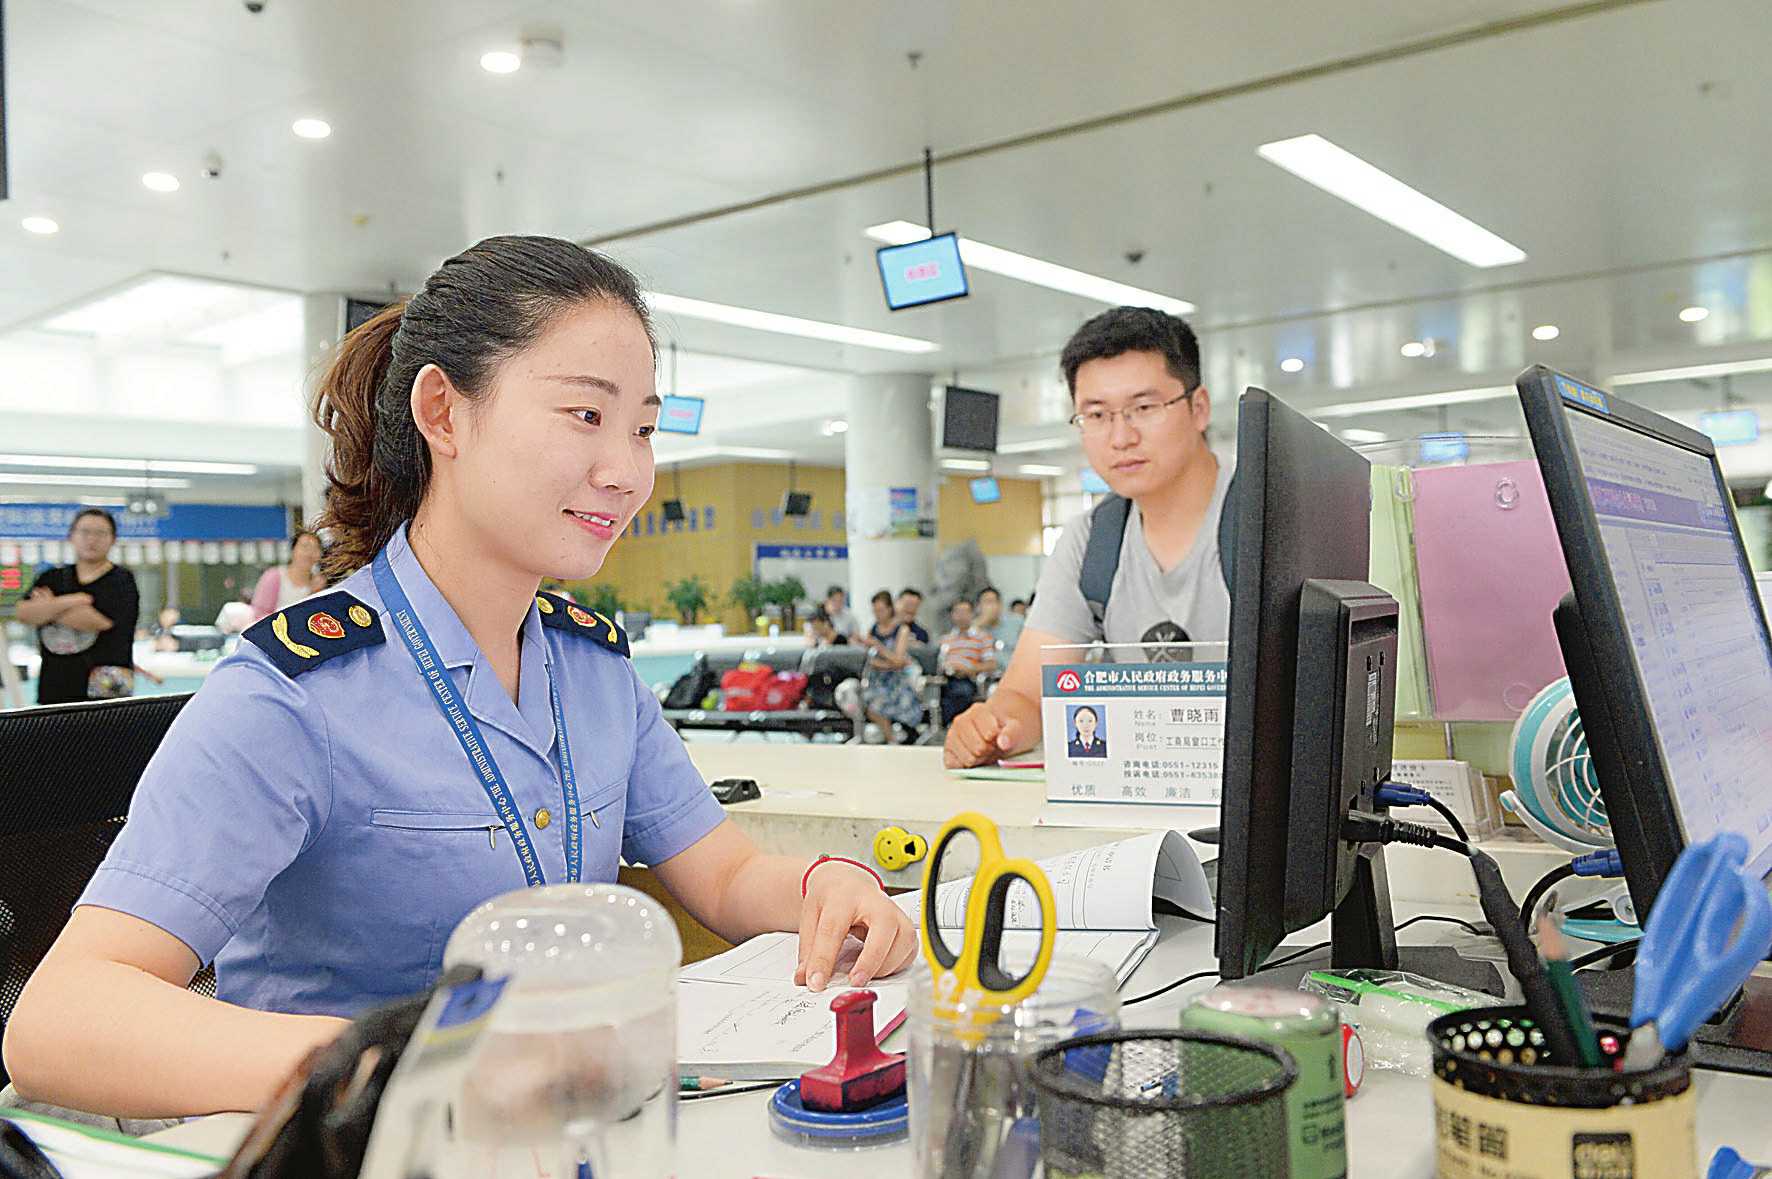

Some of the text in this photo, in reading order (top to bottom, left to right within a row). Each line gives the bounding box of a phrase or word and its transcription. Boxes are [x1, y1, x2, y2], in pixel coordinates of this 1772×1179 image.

[396, 609, 423, 650] GOVERNMENT
[417, 648, 435, 670] HEFEI
[427, 669, 440, 680] OF
[433, 678, 454, 705] CENTER
[447, 704, 469, 731] SERVICE
[1171, 708, 1219, 722] 曹晓雨
[462, 730, 496, 782] ADMINISTRATIVE
[490, 783, 502, 798] THE
[1072, 784, 1096, 797] 优质
[1121, 786, 1147, 798] 高效
